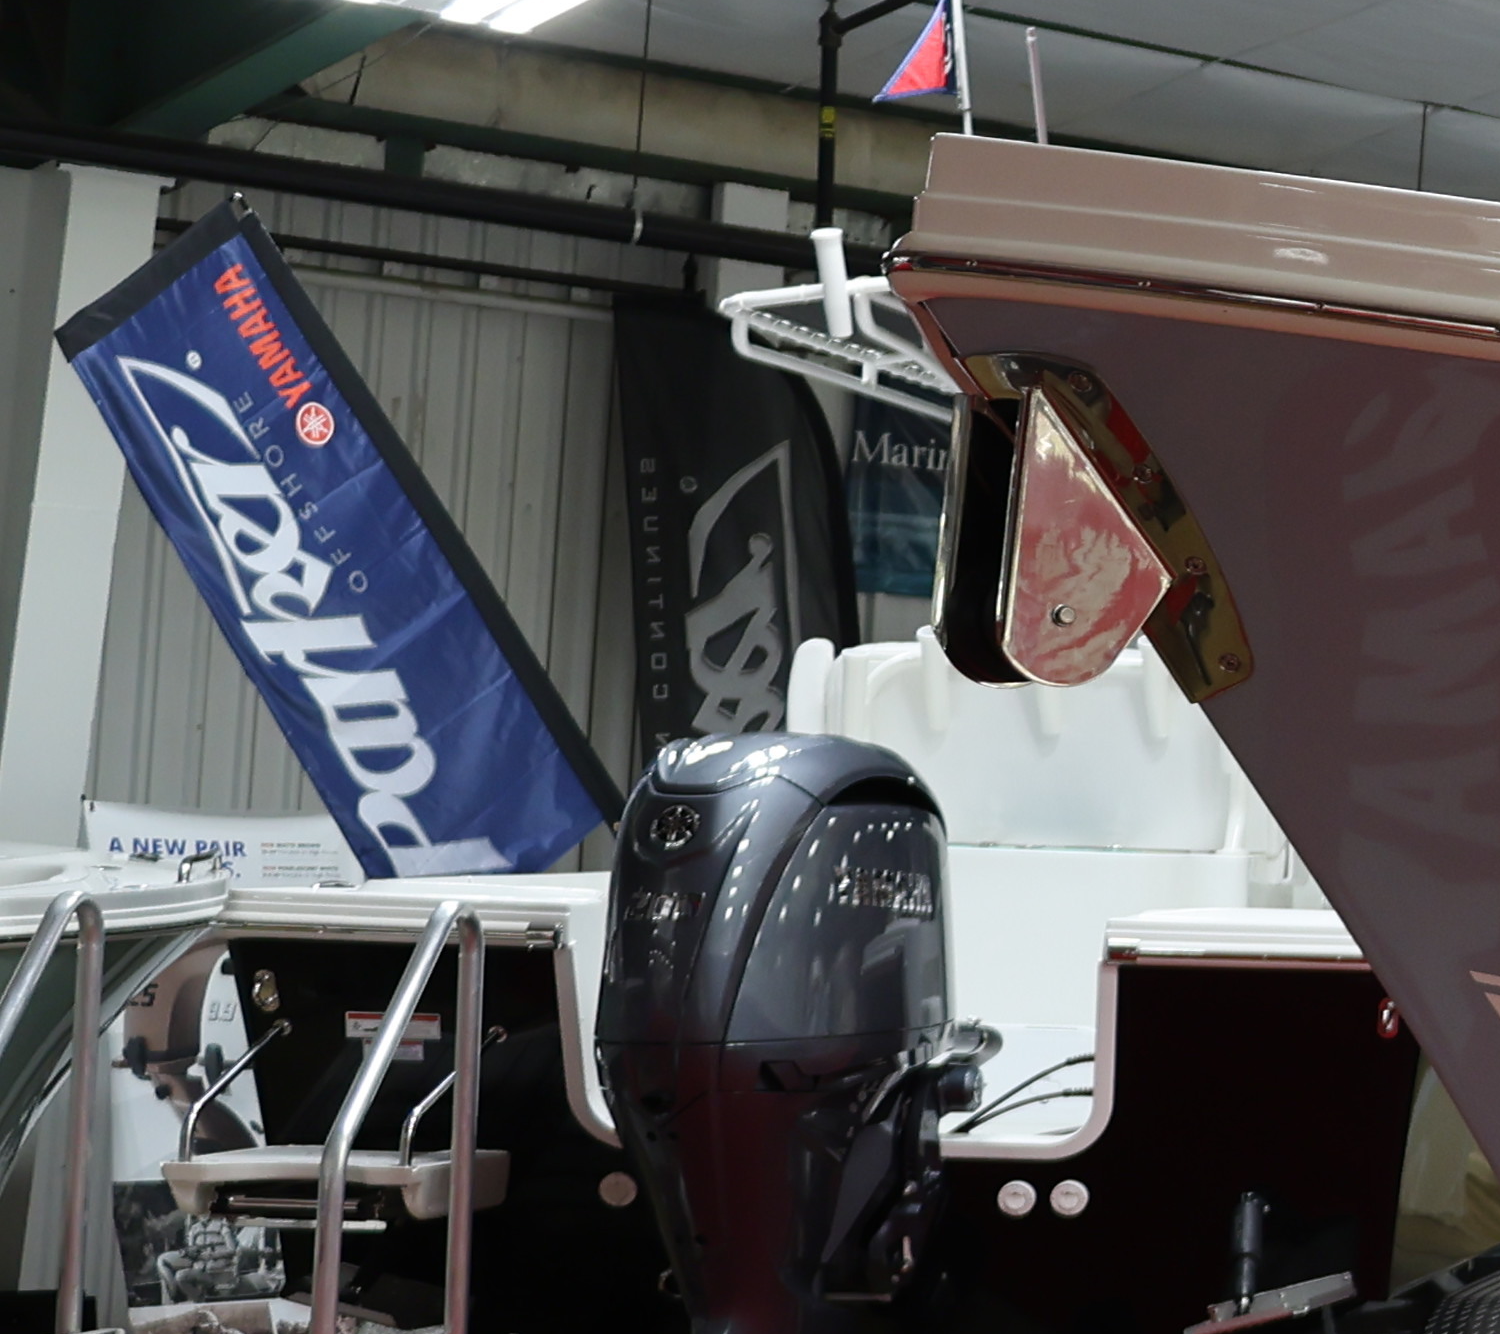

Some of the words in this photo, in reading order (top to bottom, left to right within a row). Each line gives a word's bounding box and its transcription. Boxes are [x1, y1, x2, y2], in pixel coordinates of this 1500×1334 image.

[214, 263, 300, 409] YAMAHA
[236, 390, 369, 594] OFFSHORE
[170, 425, 520, 878] Parker
[108, 836, 125, 854] A
[132, 837, 187, 856] NEW
